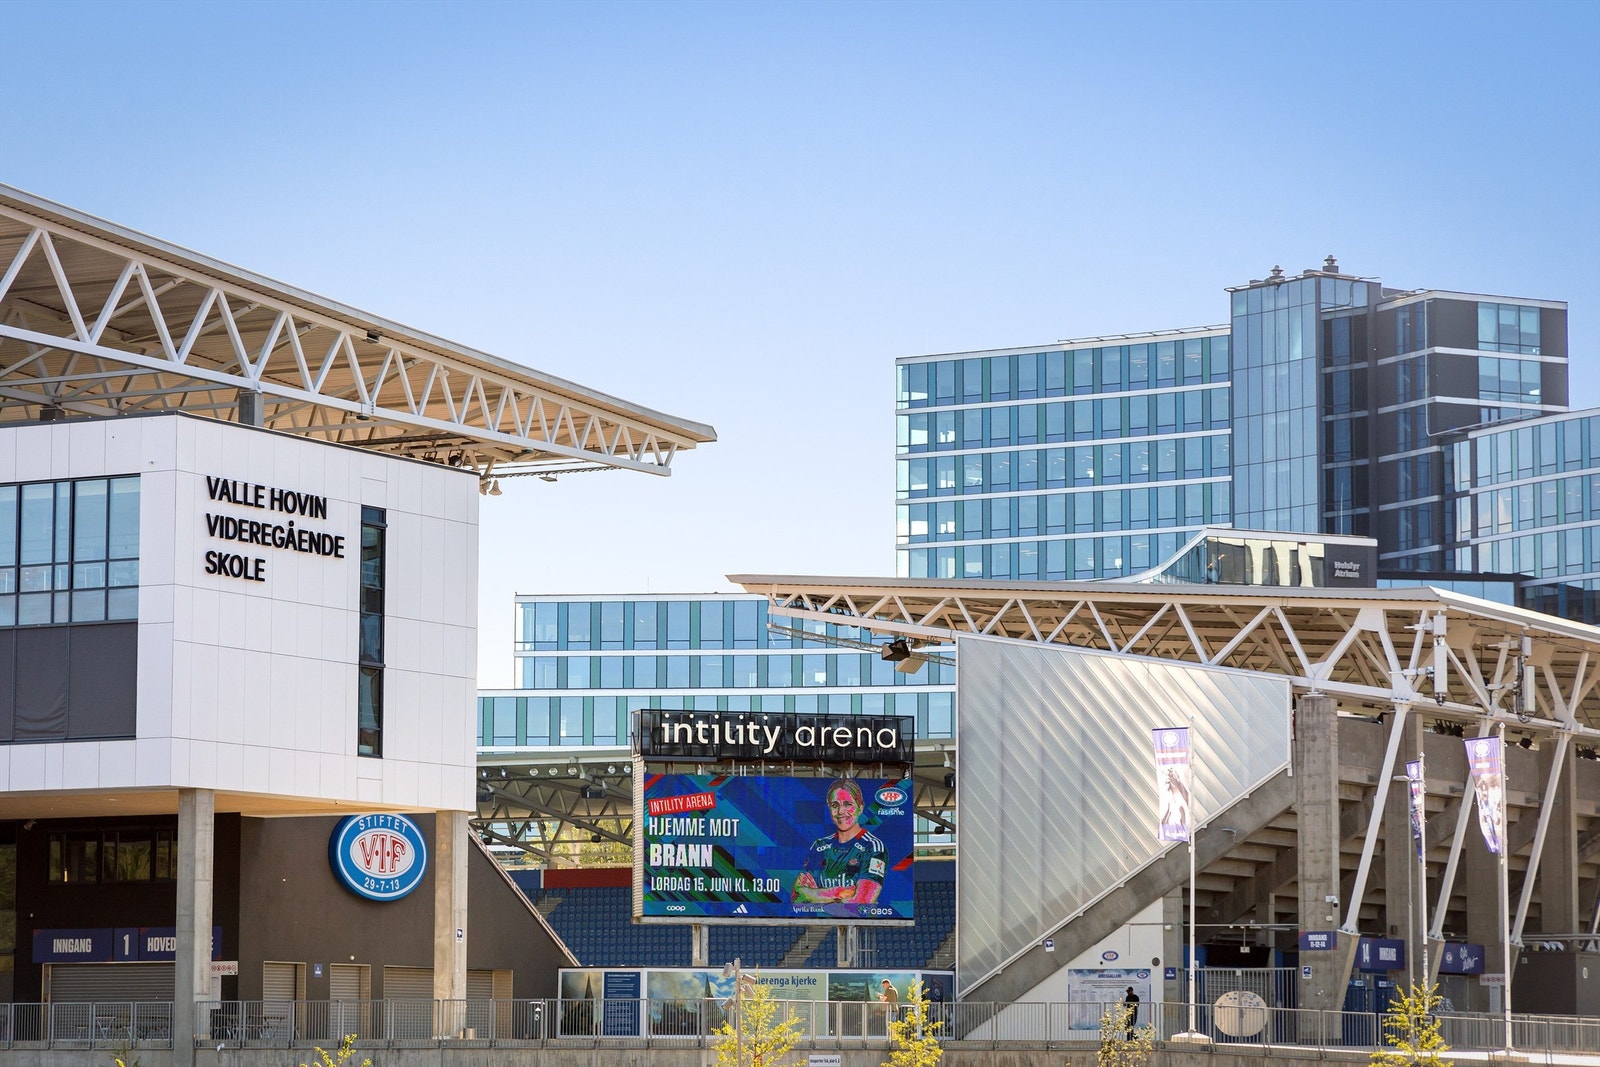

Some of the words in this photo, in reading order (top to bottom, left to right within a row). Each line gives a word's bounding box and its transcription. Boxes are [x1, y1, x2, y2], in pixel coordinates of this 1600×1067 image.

[206, 475, 265, 509] VALLE
[270, 487, 327, 520] HOVIN
[205, 513, 345, 559] VIDEREGÅENDE
[205, 550, 266, 582] SKOLE
[1334, 569, 1360, 578] Atrium
[661, 713, 781, 754] intility
[795, 725, 897, 749] arena
[650, 797, 684, 814] INTILITY
[686, 794, 714, 810] ARENA
[358, 815, 408, 833] STIFTET
[648, 817, 705, 837] HJEMME
[709, 818, 740, 837] MOT
[649, 843, 713, 867] BRANN
[364, 876, 400, 891] 29-7-13
[651, 876, 691, 892] LØRDAG
[693, 877, 708, 892] 15.
[709, 877, 732, 893] JUNI
[734, 878, 750, 893] KL.
[752, 878, 780, 893] 13.00
[53, 938, 92, 954] INNGANG
[123, 934, 130, 956] 1
[791, 976, 817, 987] kjerke
